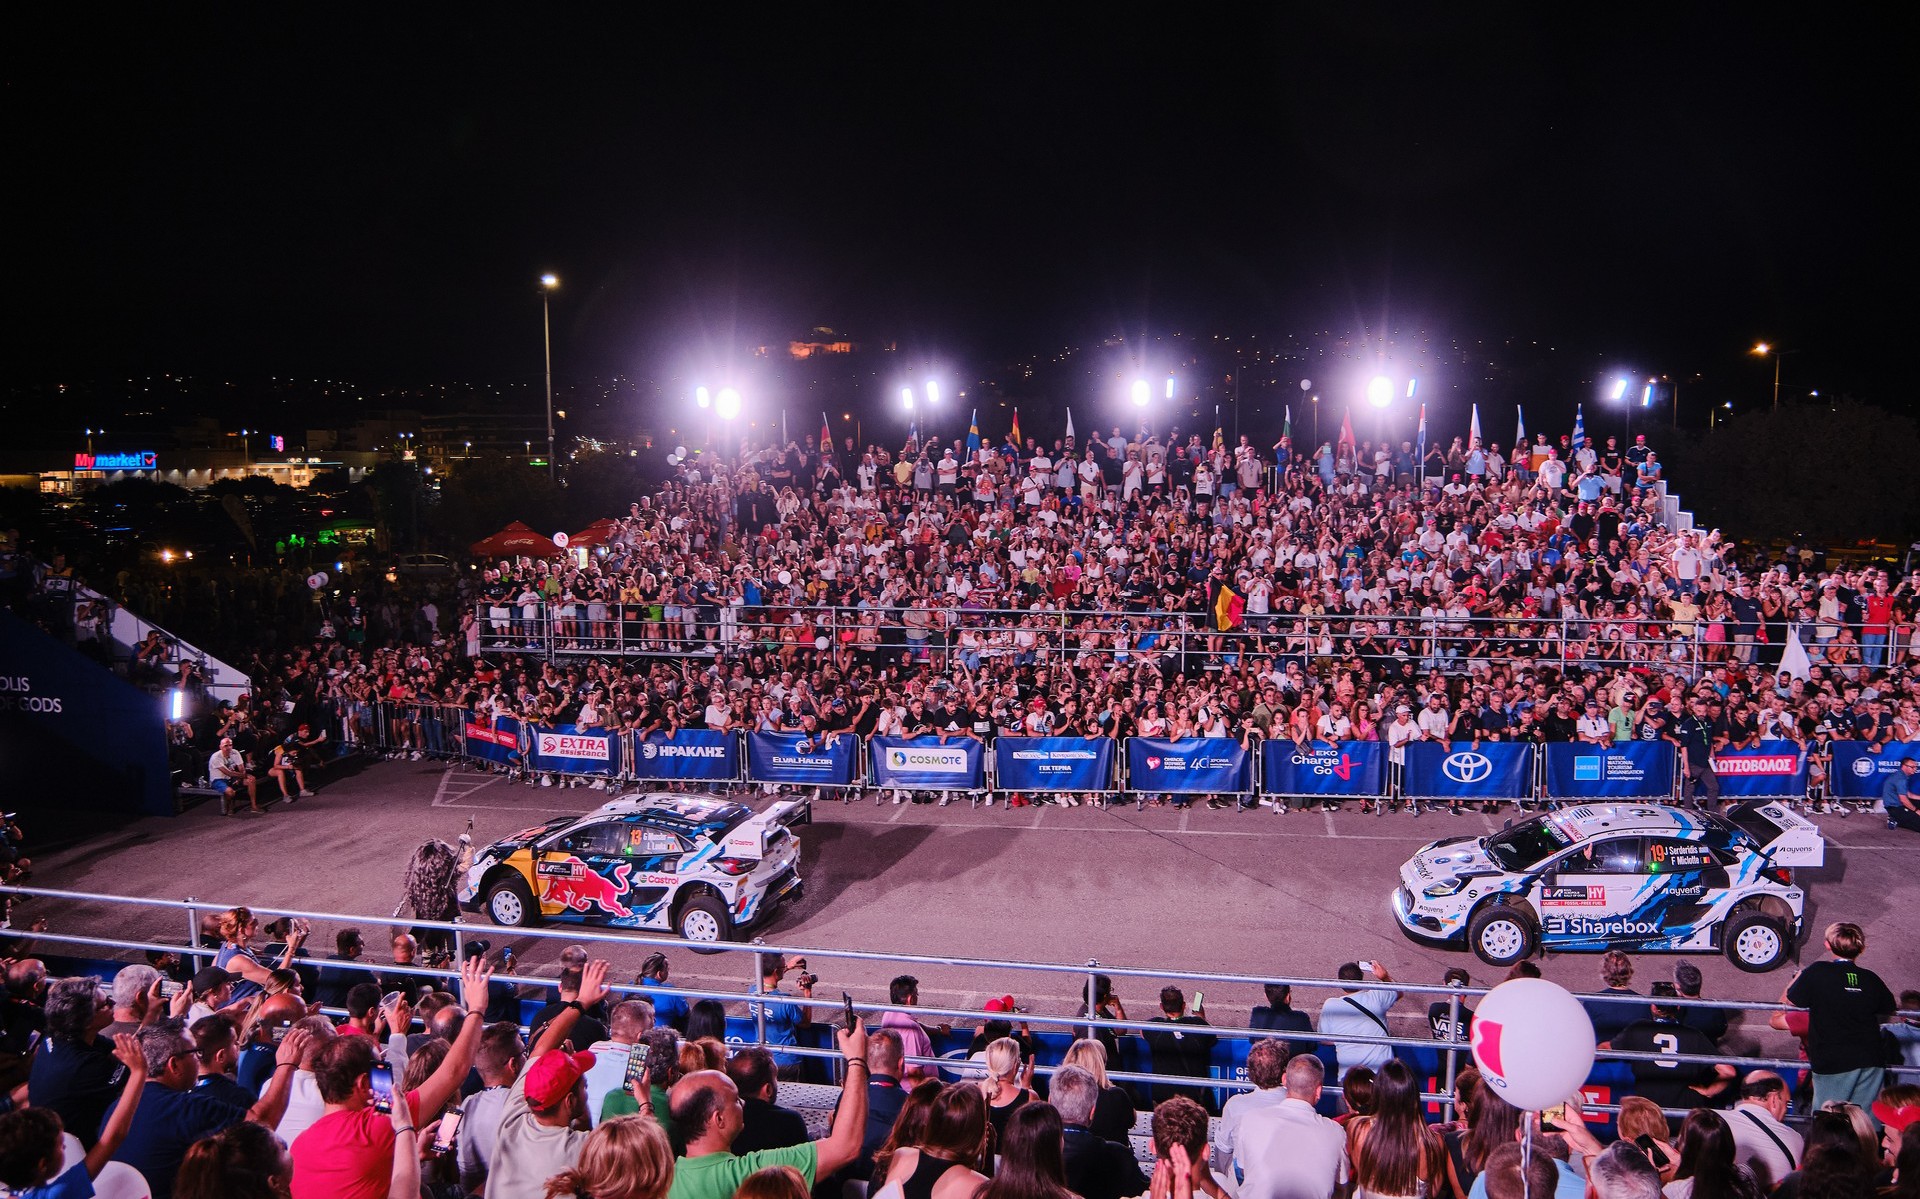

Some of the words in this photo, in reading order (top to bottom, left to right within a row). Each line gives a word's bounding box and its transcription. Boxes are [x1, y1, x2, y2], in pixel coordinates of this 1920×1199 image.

[75, 453, 95, 469] My
[96, 452, 141, 466] market
[19, 697, 63, 713] GODS
[560, 737, 606, 751] EXTRA
[560, 749, 607, 758] assistance
[659, 745, 725, 758] ΗΡΑΚΛΗΣ
[909, 755, 962, 765] COSMOTE
[1291, 753, 1340, 767] Charge
[1313, 765, 1333, 775] Go
[630, 829, 642, 846] 13
[1650, 844, 1665, 862] 19
[1664, 847, 1669, 856] J
[1671, 856, 1676, 866] F
[573, 863, 586, 876] HY
[648, 875, 679, 885] Castrol
[1588, 887, 1604, 899] HY
[1669, 886, 1701, 895] ayvens
[1423, 905, 1444, 913] ayvens
[1570, 918, 1659, 934] Sharebox
[1653, 1032, 1679, 1068] 3
